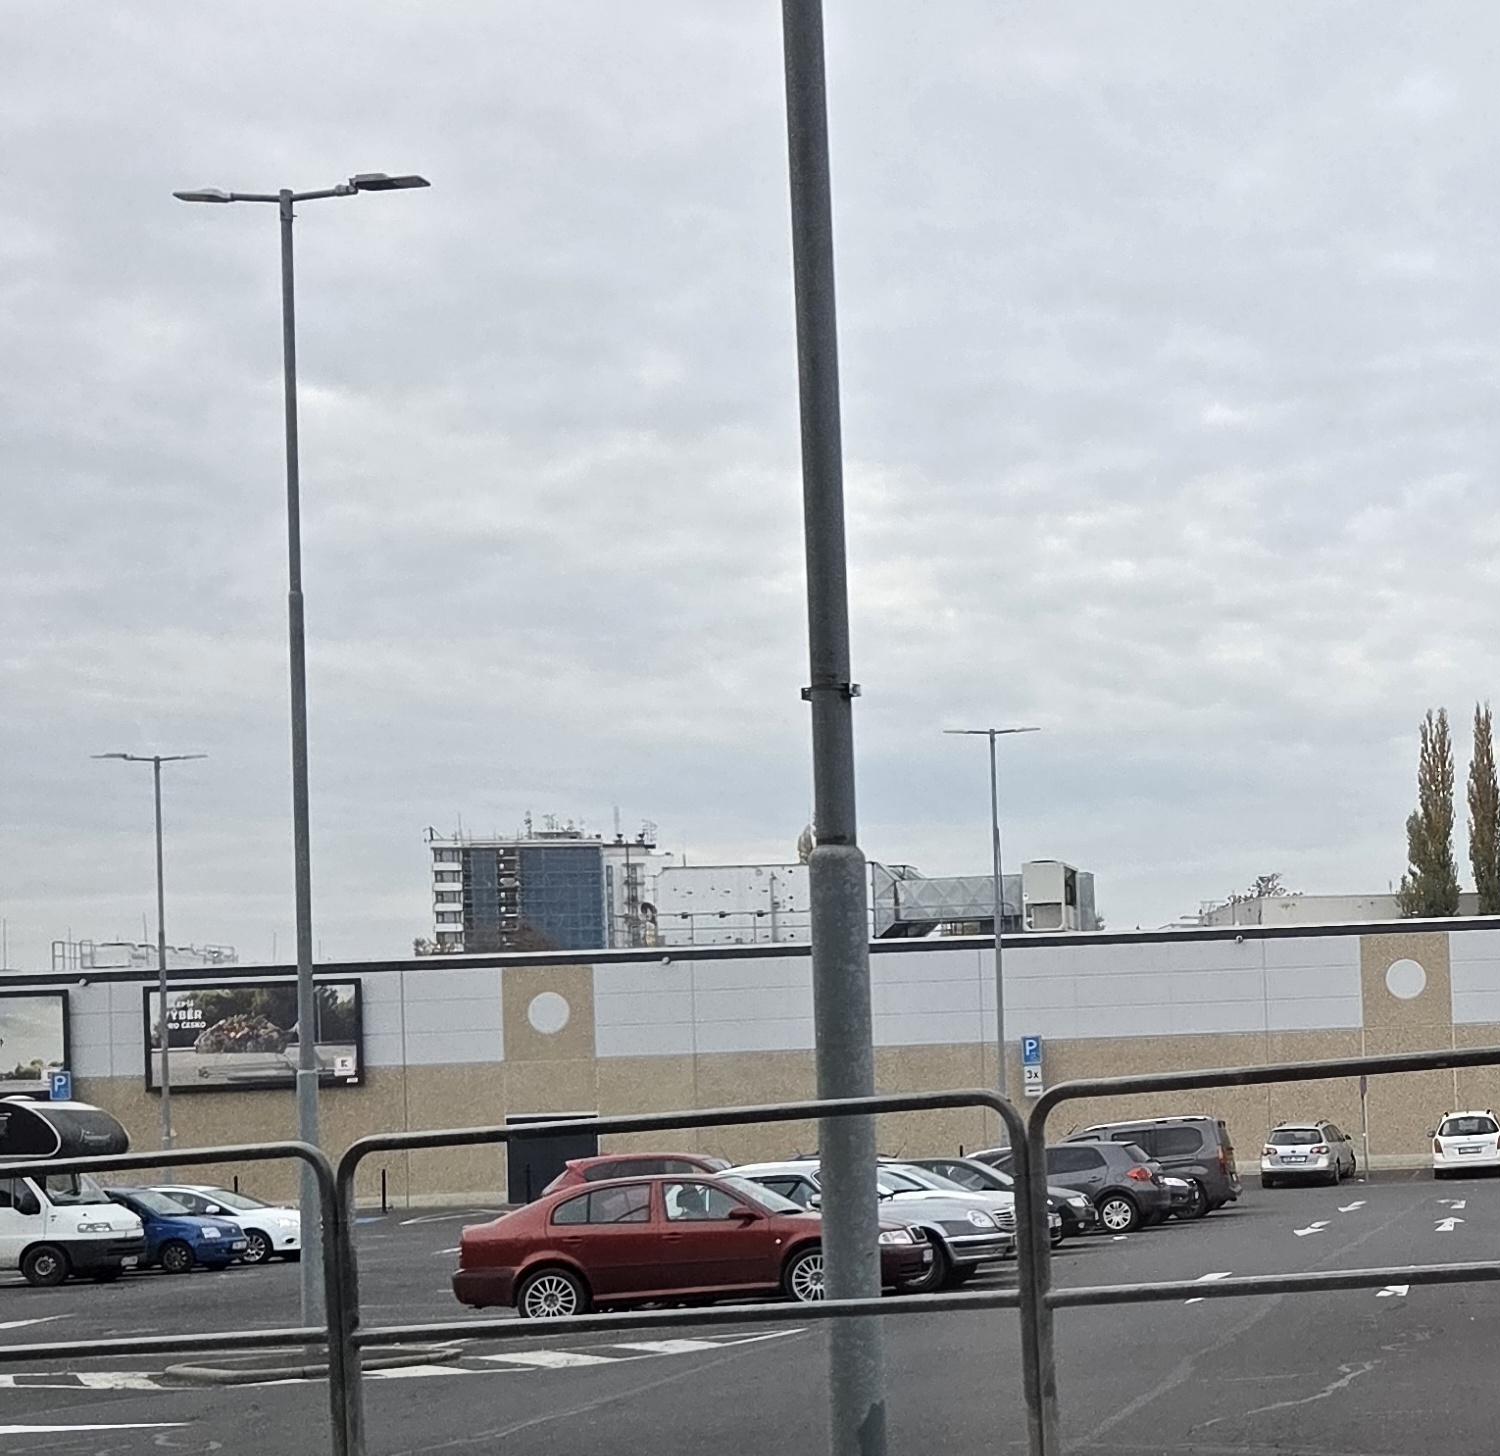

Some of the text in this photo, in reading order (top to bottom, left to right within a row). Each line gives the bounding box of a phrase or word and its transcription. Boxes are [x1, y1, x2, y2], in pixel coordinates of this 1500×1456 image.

[1025, 1040, 1037, 1056] P
[1027, 1070, 1039, 1079] 3x
[54, 1076, 66, 1092] P
